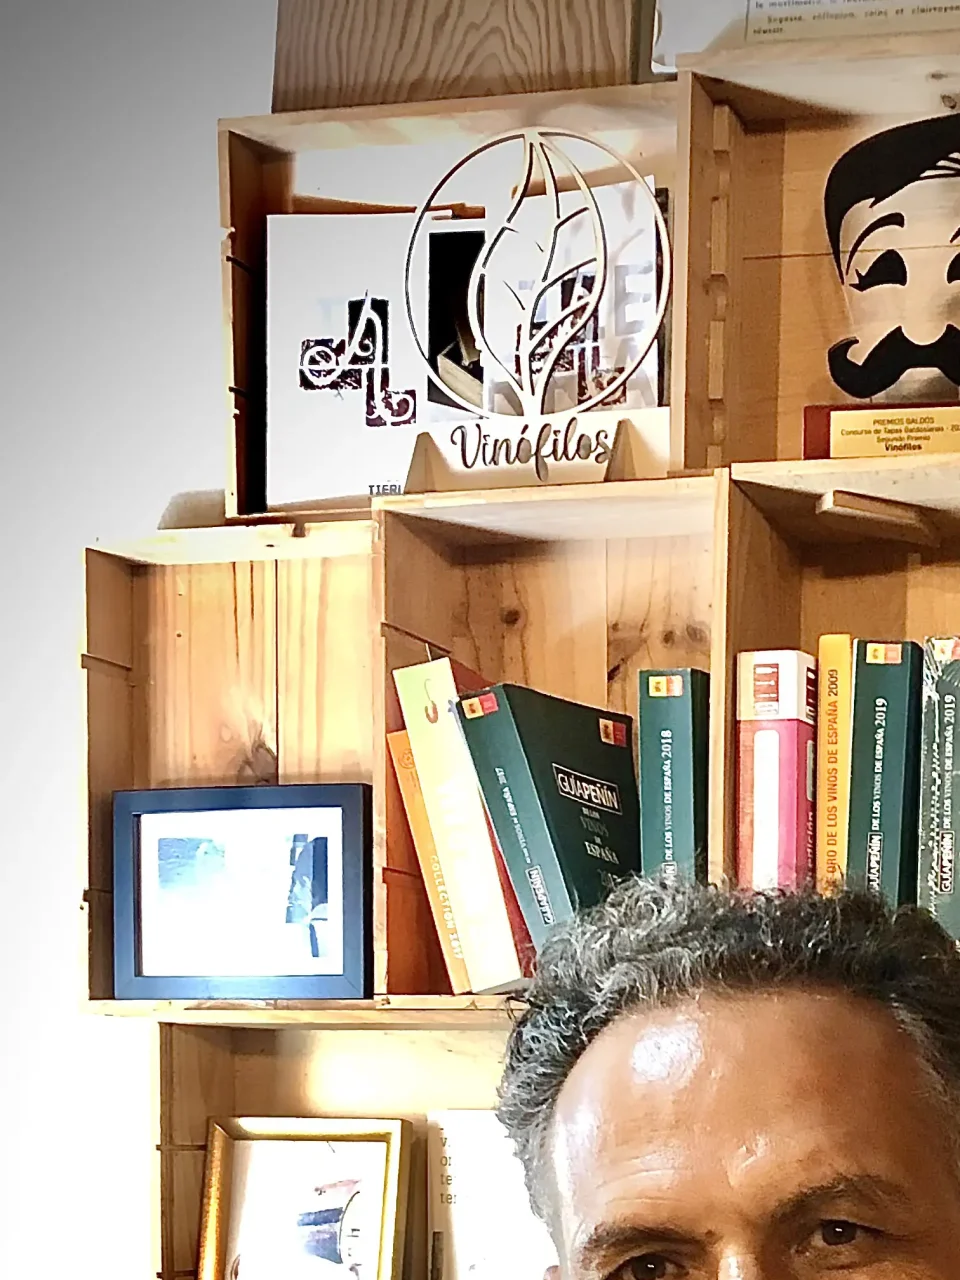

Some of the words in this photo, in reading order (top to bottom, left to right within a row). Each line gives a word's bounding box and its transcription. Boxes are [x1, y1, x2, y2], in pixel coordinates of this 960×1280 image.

[450, 416, 613, 482] Vinófilos
[827, 669, 839, 697] 2009
[874, 698, 888, 728] 2019
[943, 695, 956, 723] 2019
[826, 701, 838, 745] ESPAÑA
[660, 730, 673, 759] 2018
[874, 728, 885, 759] ESPAÑA
[943, 726, 954, 757] ESPAÑA
[827, 749, 838, 764] DE
[874, 760, 883, 773] DE
[944, 758, 953, 770] DE
[661, 760, 672, 791] ESPAÑA
[827, 767, 838, 802] VINOS
[872, 773, 882, 800] VINOS
[943, 771, 952, 798] VINOS
[557, 772, 620, 811] GUÍAPEÑÍN
[662, 791, 672, 804] DE
[663, 805, 672, 830] VINOS
[827, 806, 838, 828] LOS
[872, 801, 881, 818] LOS
[943, 799, 952, 815] LOS
[872, 818, 880, 831] DE
[943, 816, 951, 829] DE
[663, 831, 673, 848] LOS
[827, 832, 837, 846] DE
[663, 848, 673, 861] DE
[826, 849, 837, 874] ORO
[430, 855, 455, 930] COLLECTION
